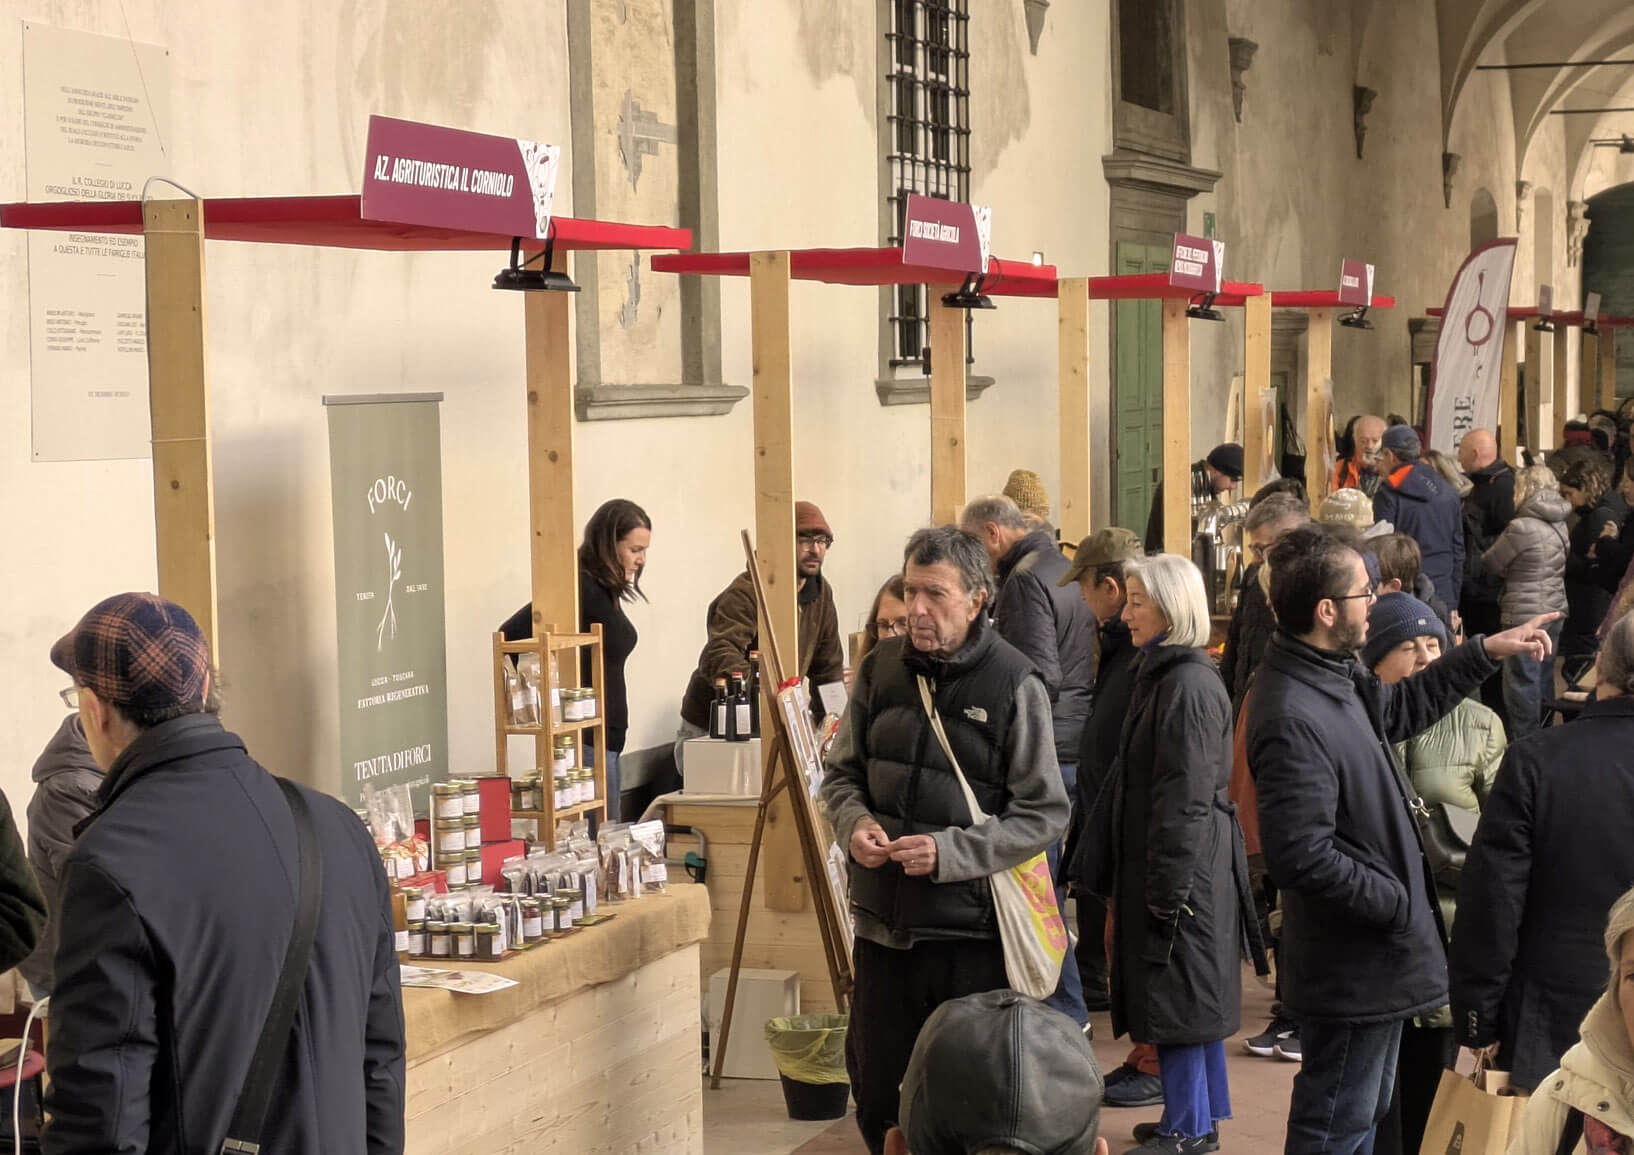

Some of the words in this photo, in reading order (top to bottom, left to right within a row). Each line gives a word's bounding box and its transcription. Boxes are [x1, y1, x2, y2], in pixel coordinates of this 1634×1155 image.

[374, 154, 390, 181] AZ.
[391, 157, 460, 191] AGRITURISTICA
[460, 167, 470, 192] IL
[471, 169, 514, 198] CORNIOLO
[58, 245, 79, 254] QUESTA
[367, 475, 412, 514] FORCI
[357, 694, 386, 709] FATTORIA
[386, 684, 429, 703] RIGENERATIVA
[354, 754, 393, 782] TENUTA
[393, 751, 404, 771] DI
[404, 743, 432, 768] FORCI
